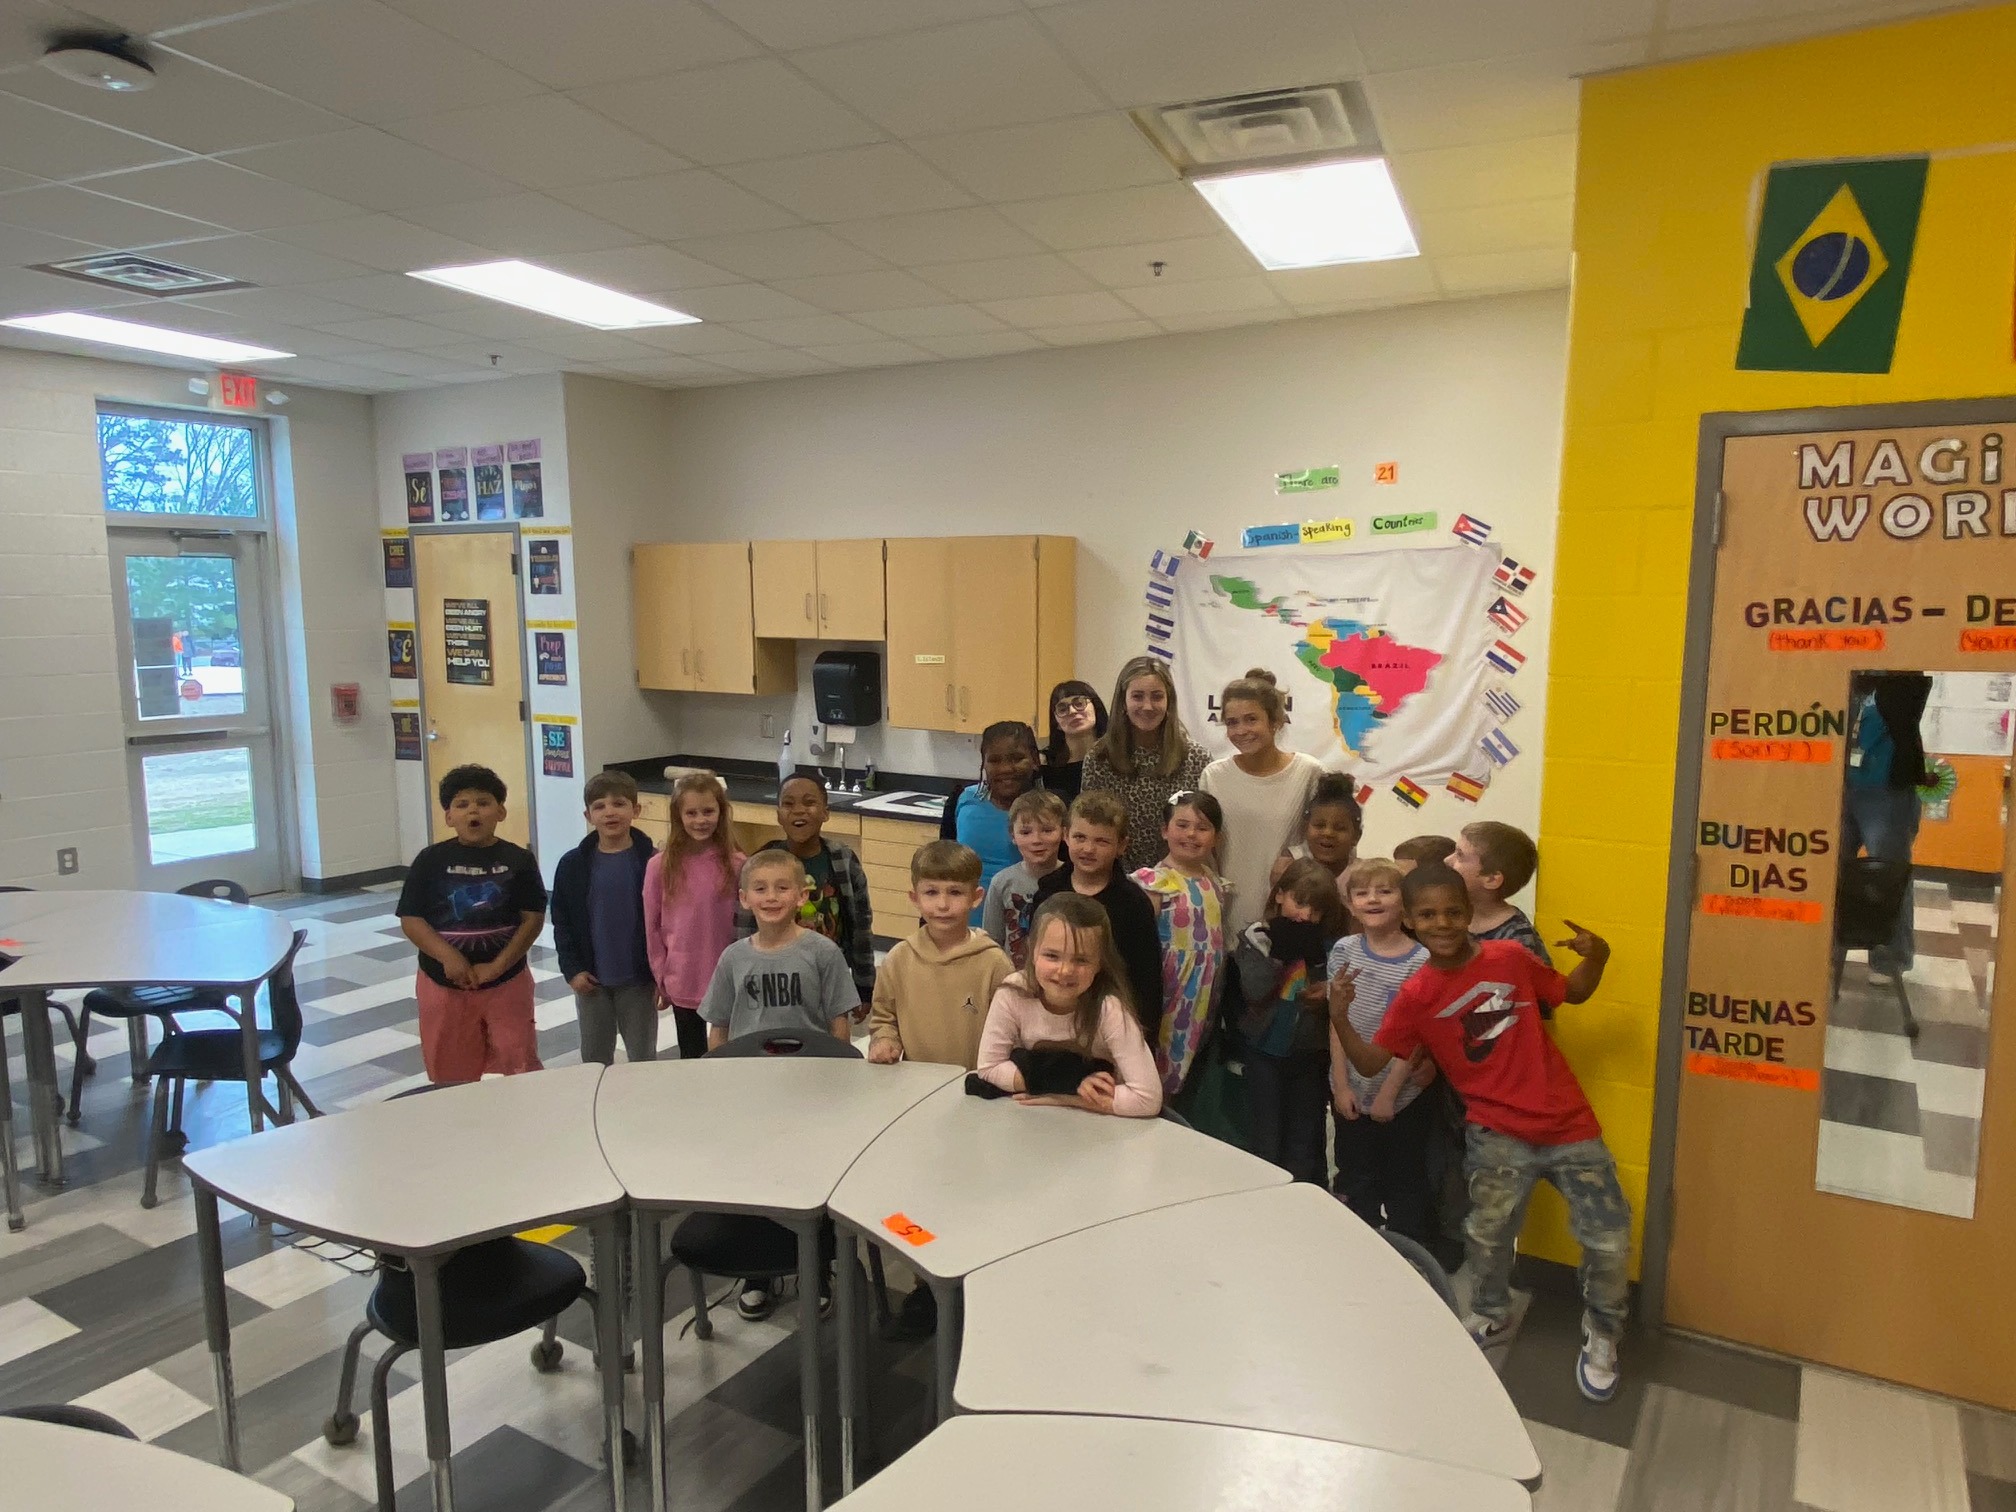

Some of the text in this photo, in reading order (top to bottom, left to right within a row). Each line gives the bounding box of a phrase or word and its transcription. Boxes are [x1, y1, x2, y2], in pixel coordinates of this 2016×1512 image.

[221, 374, 257, 407] EXIT
[1377, 466, 1395, 480] 21
[1302, 522, 1352, 540] speaking
[1372, 515, 1424, 530] Countries
[447, 648, 484, 658] WE CAN
[447, 657, 490, 667] HELP YOU
[1710, 701, 1846, 737] PERDÓN
[1700, 821, 1830, 856] BUENOS
[492, 865, 509, 874] UP
[1729, 862, 1809, 894] DIAS
[762, 972, 803, 1008] NBA
[1687, 991, 1817, 1027] BUENAS
[1685, 1025, 1786, 1063] TARDE
